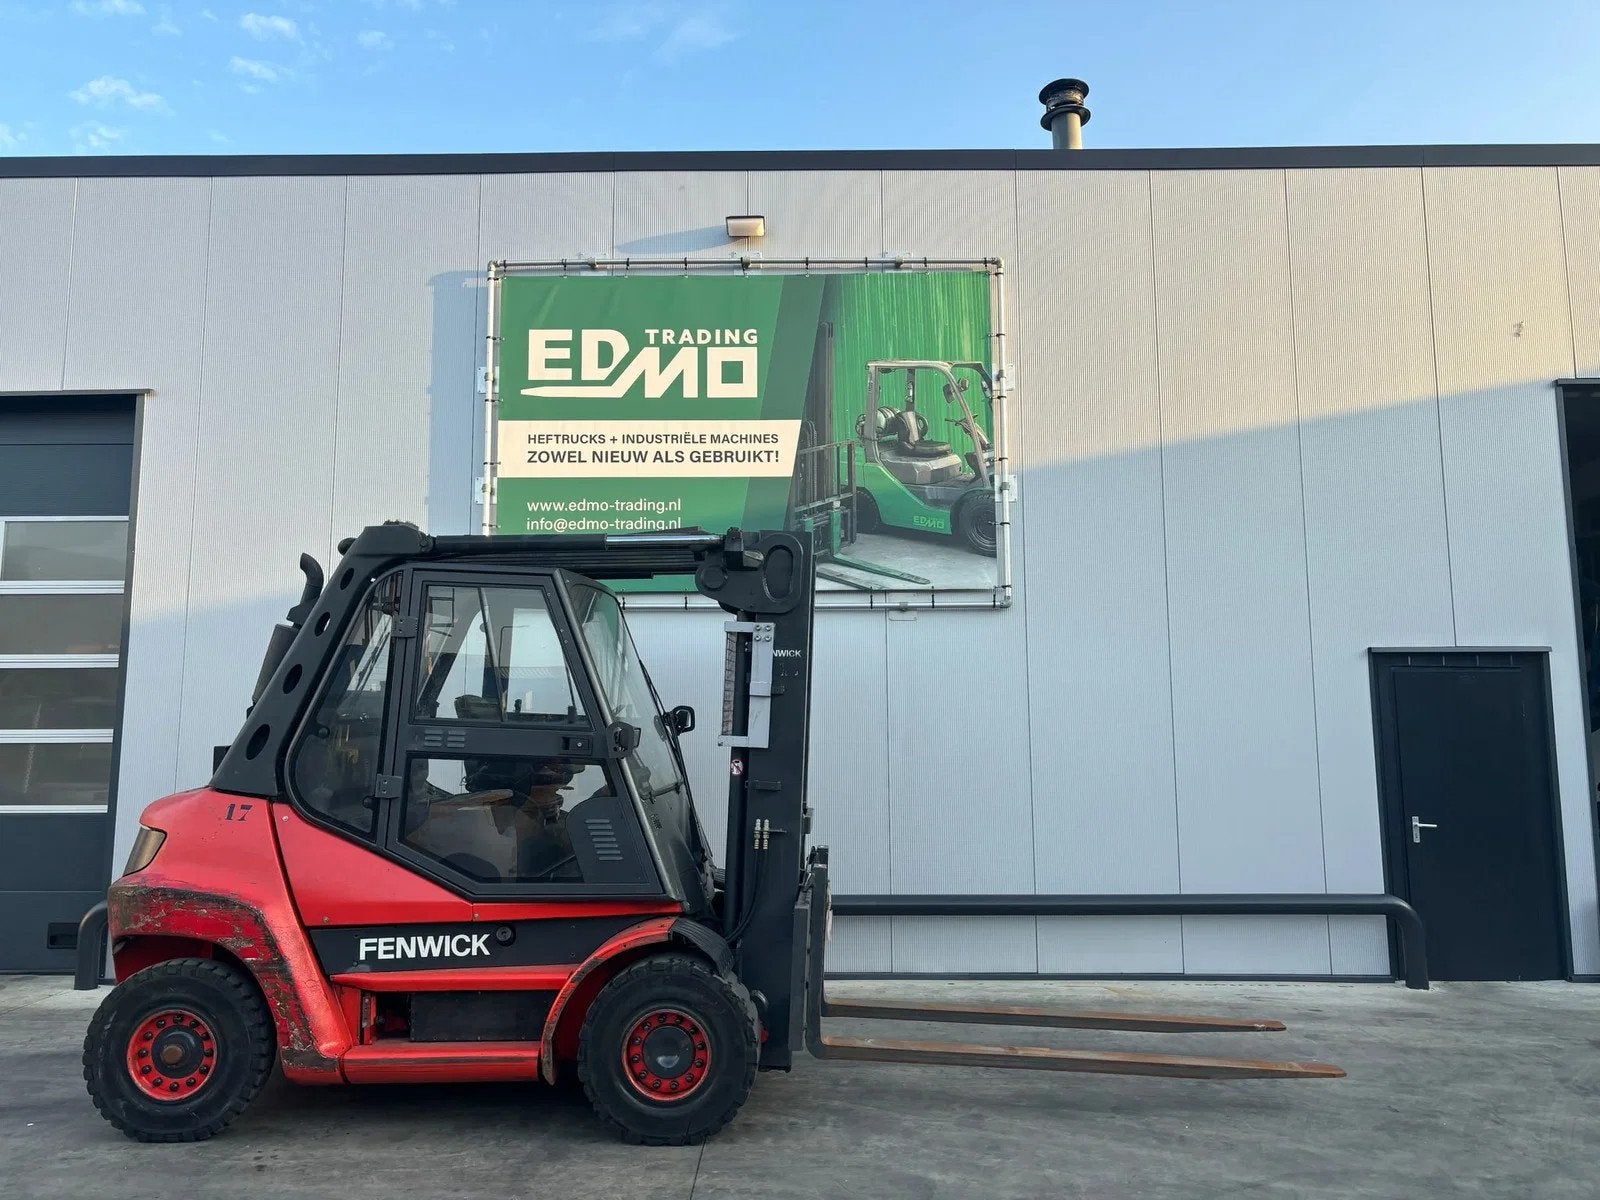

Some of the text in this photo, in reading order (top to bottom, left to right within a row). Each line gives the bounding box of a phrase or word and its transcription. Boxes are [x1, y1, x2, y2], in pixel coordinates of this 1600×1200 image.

[645, 329, 758, 344] TRADING
[520, 329, 758, 398] EDMO
[527, 431, 779, 444] HEFTRUCKS + INDUSTRIËLE MACHINES
[527, 450, 779, 463] ZOWEL NIEUW ALS GEBRUIKT!
[526, 498, 681, 514] www.edmo-trading.nl
[526, 517, 681, 532] info@edmo-trading.nl
[225, 803, 254, 821] 17
[360, 933, 491, 960] FENWICK
